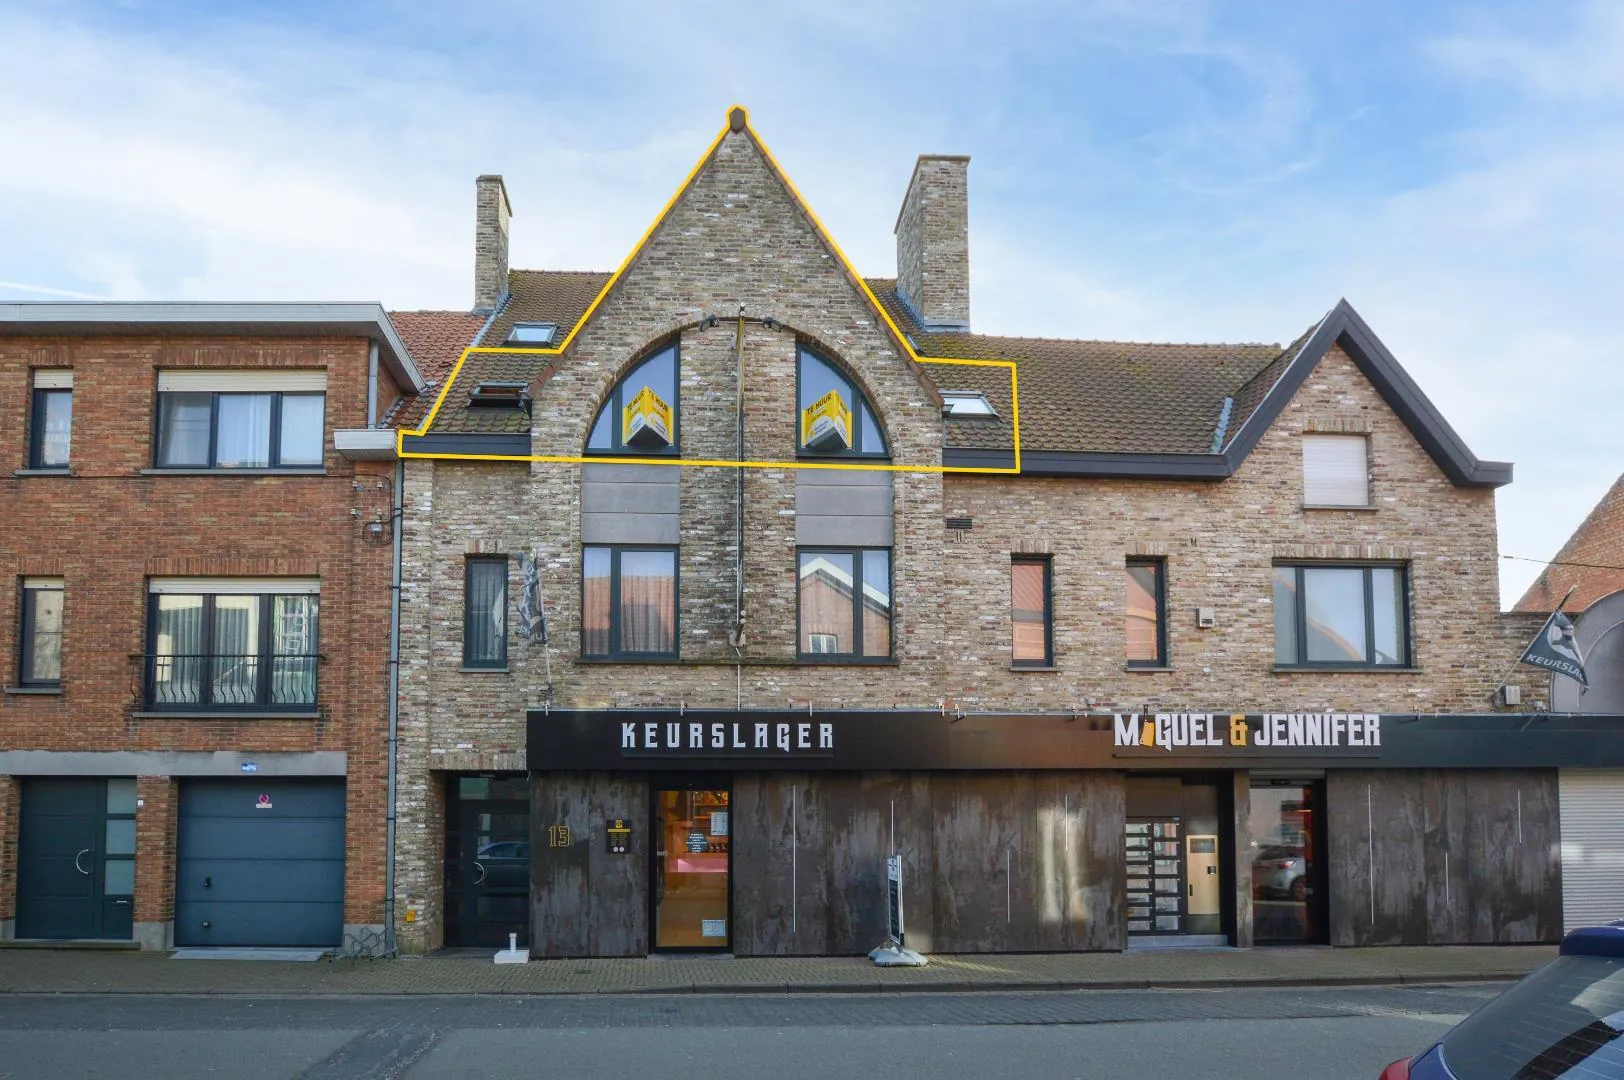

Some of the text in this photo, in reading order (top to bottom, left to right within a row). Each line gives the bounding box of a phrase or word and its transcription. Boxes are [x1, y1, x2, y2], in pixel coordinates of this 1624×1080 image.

[815, 393, 832, 409] HUUR
[621, 722, 833, 752] KEURSLAGER
[1229, 713, 1248, 747] &
[1254, 712, 1381, 747] JENNIFER
[549, 825, 570, 847] 13
